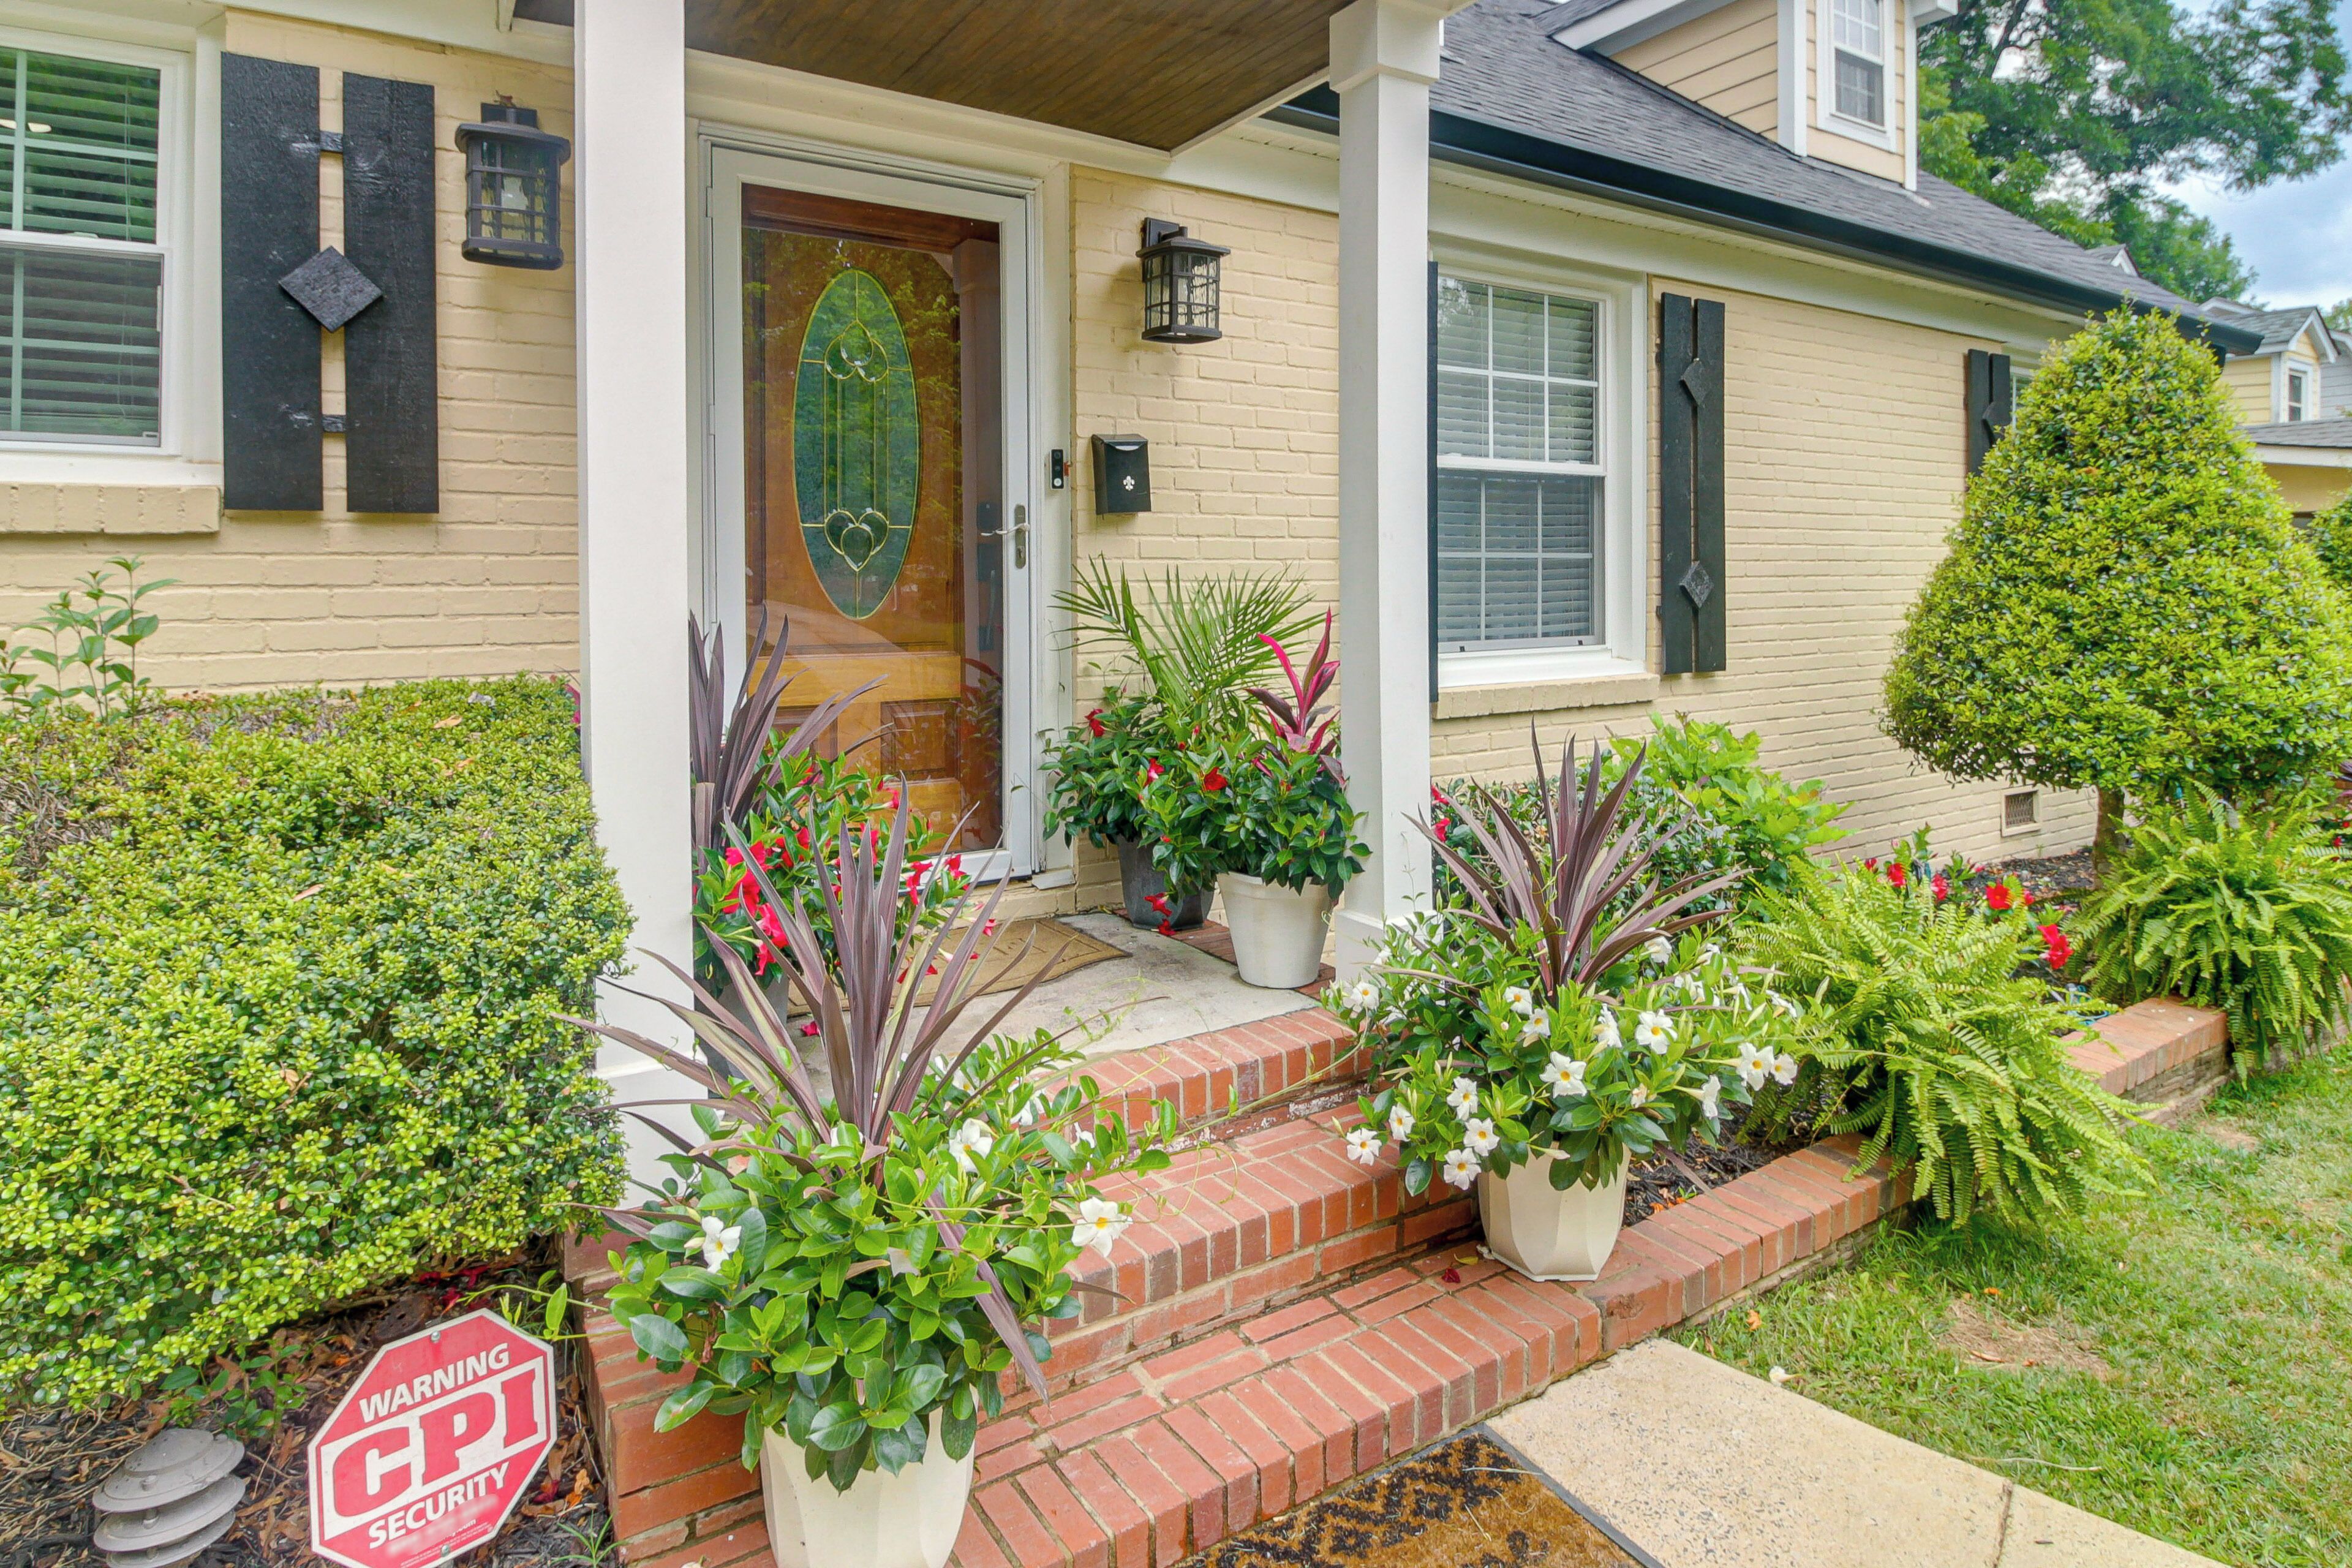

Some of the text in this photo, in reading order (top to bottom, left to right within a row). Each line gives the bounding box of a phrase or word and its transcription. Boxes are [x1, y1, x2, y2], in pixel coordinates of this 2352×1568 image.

[359, 1343, 510, 1423] WARNING
[333, 1369, 538, 1517] CPI
[369, 1461, 510, 1549] SECURITY
